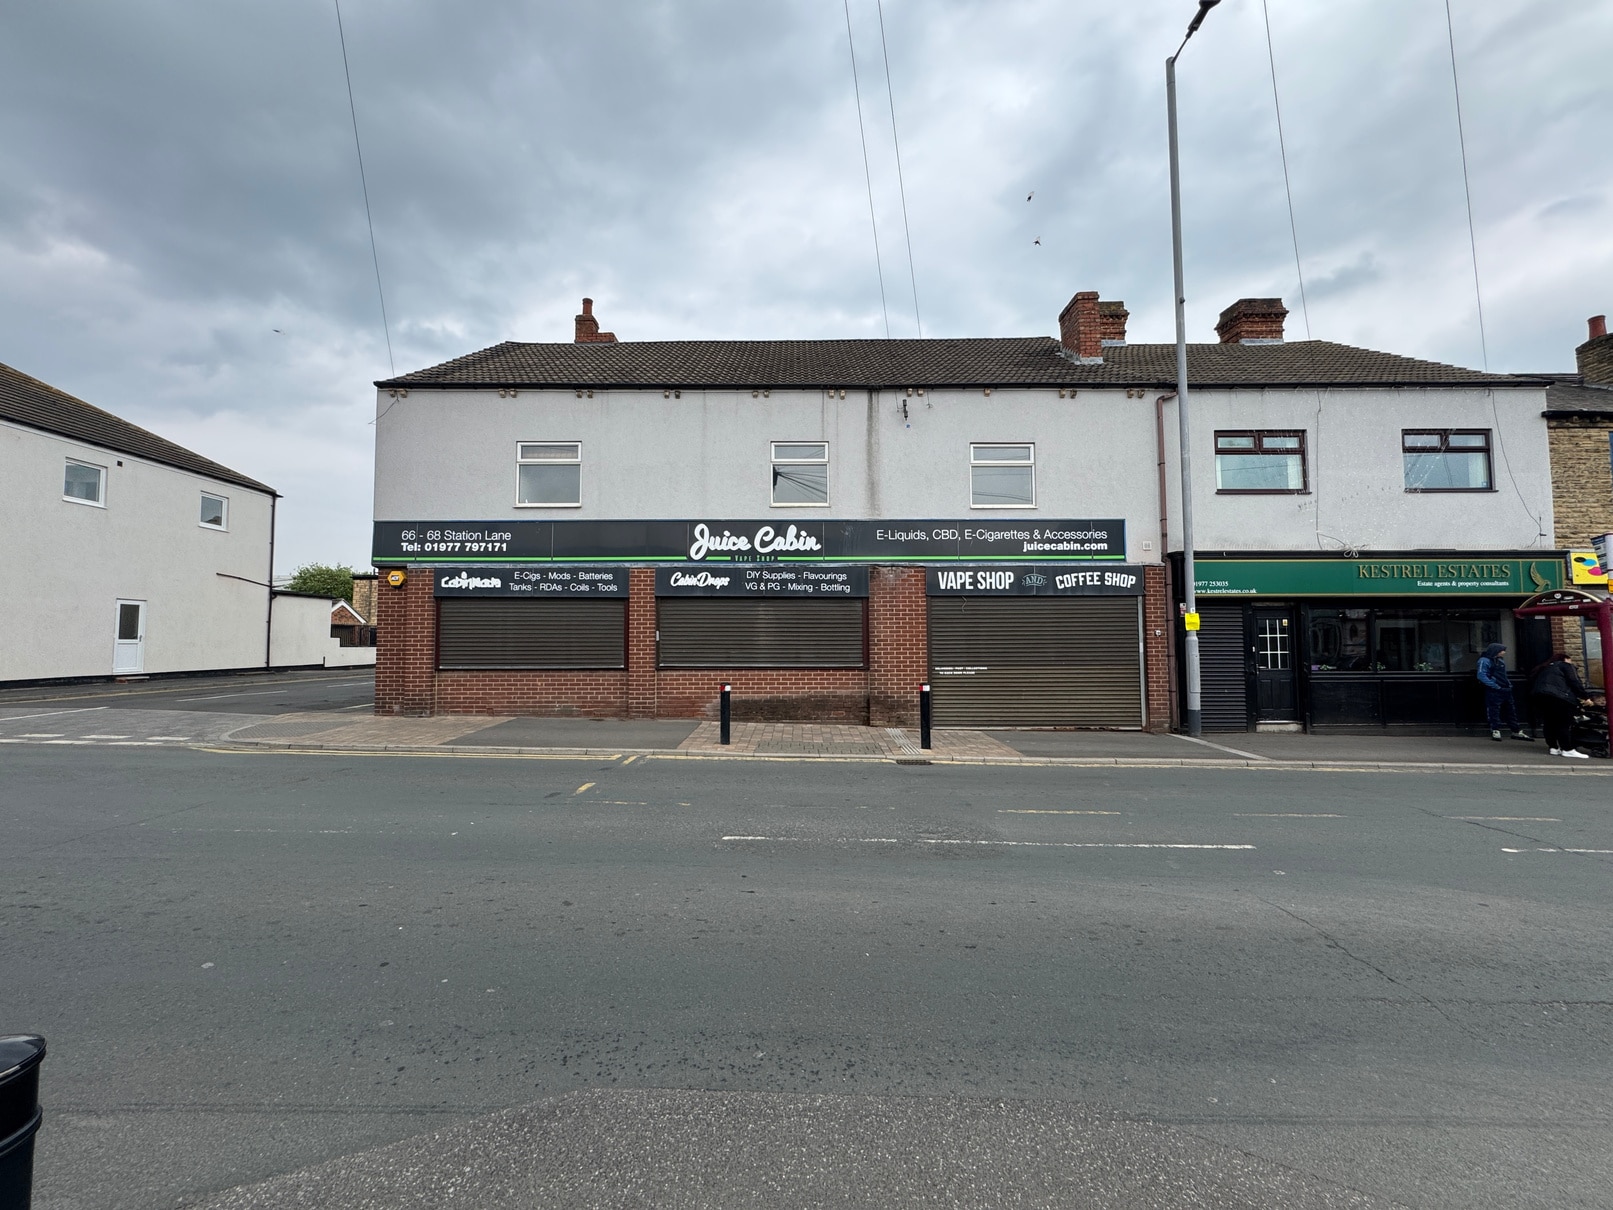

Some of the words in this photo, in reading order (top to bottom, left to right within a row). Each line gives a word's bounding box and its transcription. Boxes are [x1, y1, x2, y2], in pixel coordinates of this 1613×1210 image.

[401, 530, 416, 541] 66
[426, 530, 441, 541] 68
[443, 530, 482, 541] Station
[484, 530, 512, 541] Lane
[876, 529, 929, 542] E-Liquids,
[932, 529, 961, 541] CBD,
[964, 528, 1030, 543] E-Cigarettes
[1032, 529, 1042, 540] &
[1043, 529, 1108, 540] Accessories
[400, 542, 421, 552] Tel:
[424, 542, 461, 552] 01977
[464, 542, 507, 552] 797171
[689, 523, 752, 561] Juice
[754, 524, 822, 554] Cabin
[1022, 541, 1108, 553] juicecabin.com
[514, 571, 541, 582] E-Cigs
[548, 571, 571, 581] Mods
[578, 571, 614, 581] Batteries
[746, 571, 761, 580] DIY
[762, 571, 796, 582] Supplies
[803, 572, 848, 582] Flavourings
[1358, 564, 1434, 578] KESTREL
[1437, 564, 1512, 578] ESTATES
[670, 571, 731, 589] CabinDrops
[937, 571, 974, 590] VAPE
[976, 571, 1015, 590] SHOP
[1025, 577, 1044, 586] AND
[1055, 571, 1102, 590] COFFEE
[1104, 571, 1137, 590] SHOP
[508, 582, 532, 592] Tanks
[539, 582, 563, 592] RDAs
[569, 582, 590, 592] Coils
[597, 582, 618, 592] Tools
[744, 582, 758, 591] VG
[759, 582, 766, 591] &
[767, 582, 781, 592] PG
[787, 582, 814, 593] Mixing
[820, 583, 851, 594] Bottling
